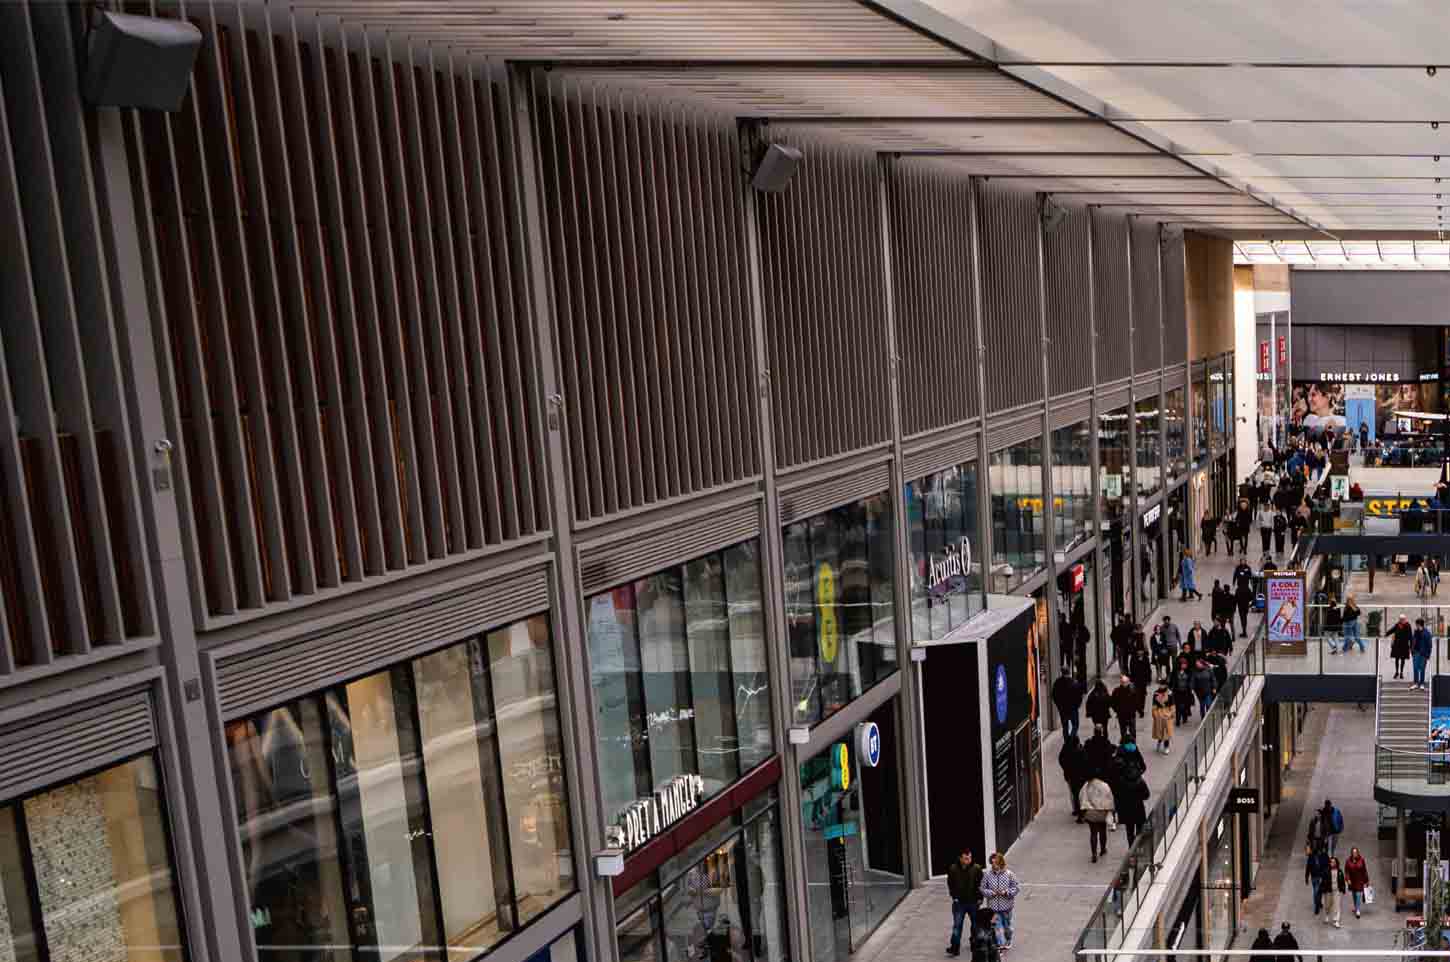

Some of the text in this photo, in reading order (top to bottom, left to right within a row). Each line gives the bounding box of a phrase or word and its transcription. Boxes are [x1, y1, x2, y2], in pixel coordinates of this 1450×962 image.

[1320, 372, 1400, 382] ERNEST JONES
[928, 543, 961, 589] Acuitis
[626, 774, 698, 852] PRET A MANGER
